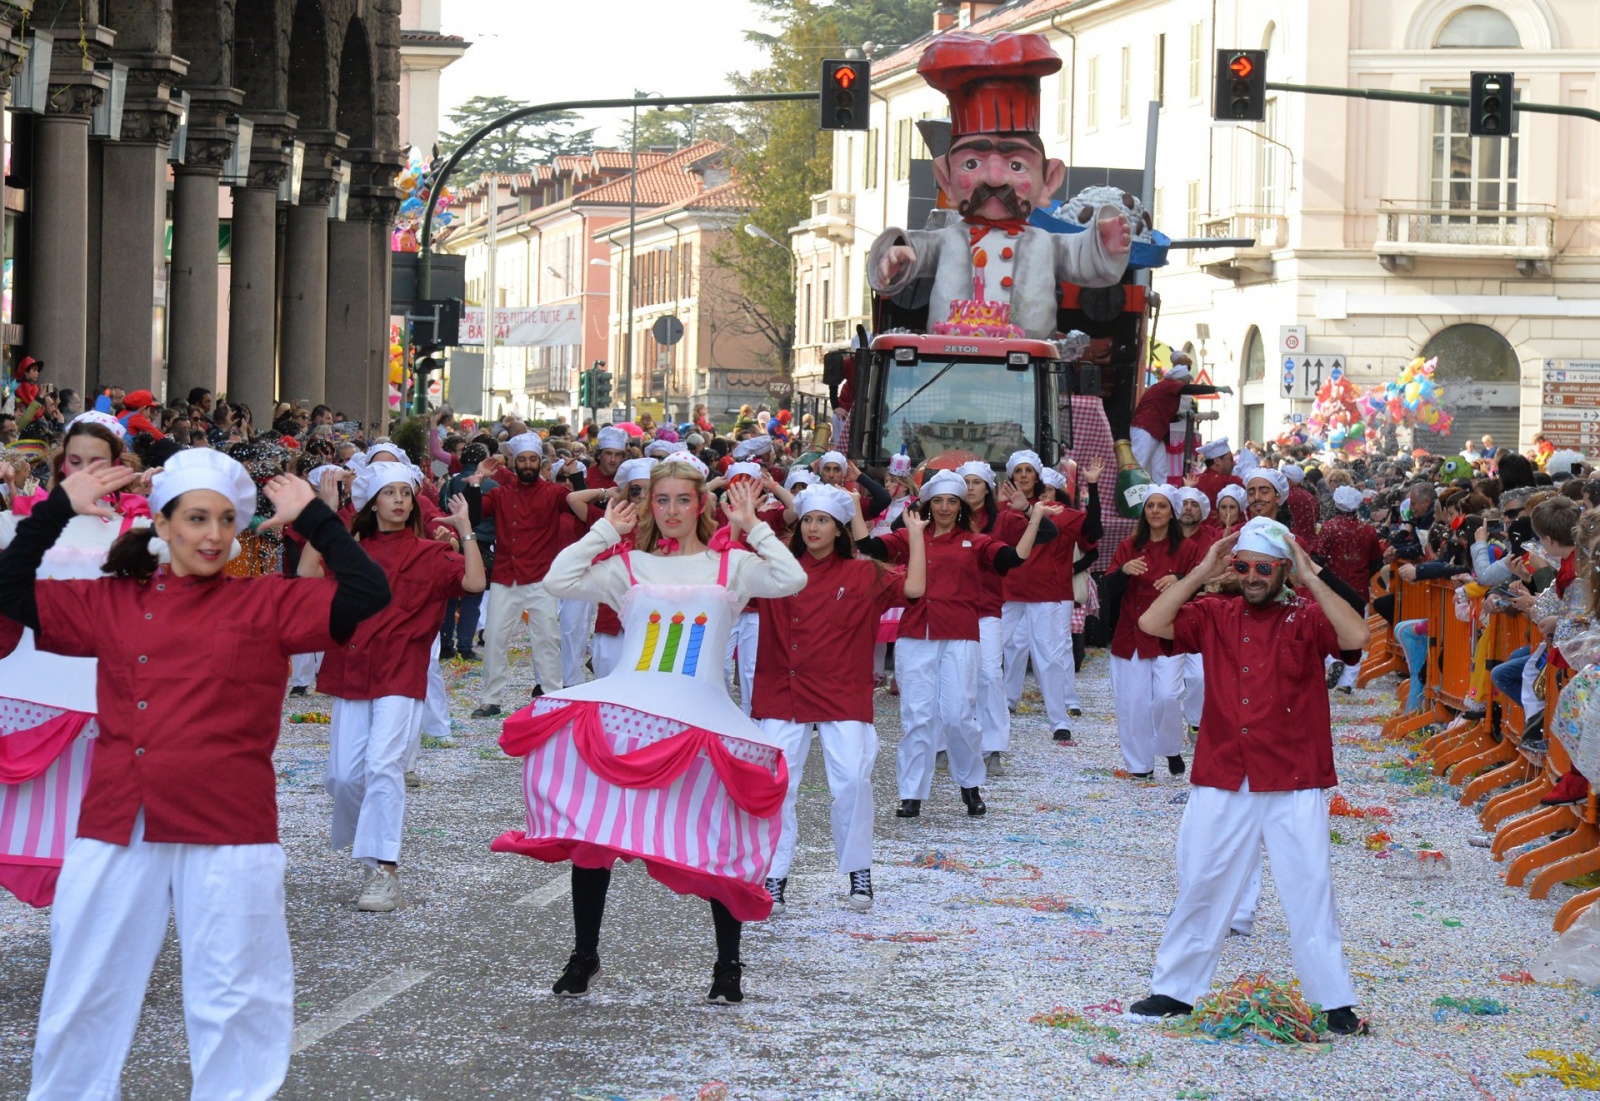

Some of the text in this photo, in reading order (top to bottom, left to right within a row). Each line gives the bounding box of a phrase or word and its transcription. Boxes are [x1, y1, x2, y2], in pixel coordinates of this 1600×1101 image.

[495, 312, 508, 325] PER
[540, 310, 561, 324] TUTTE
[944, 345, 979, 353] ZETOR
[1127, 488, 1137, 497] Sa
